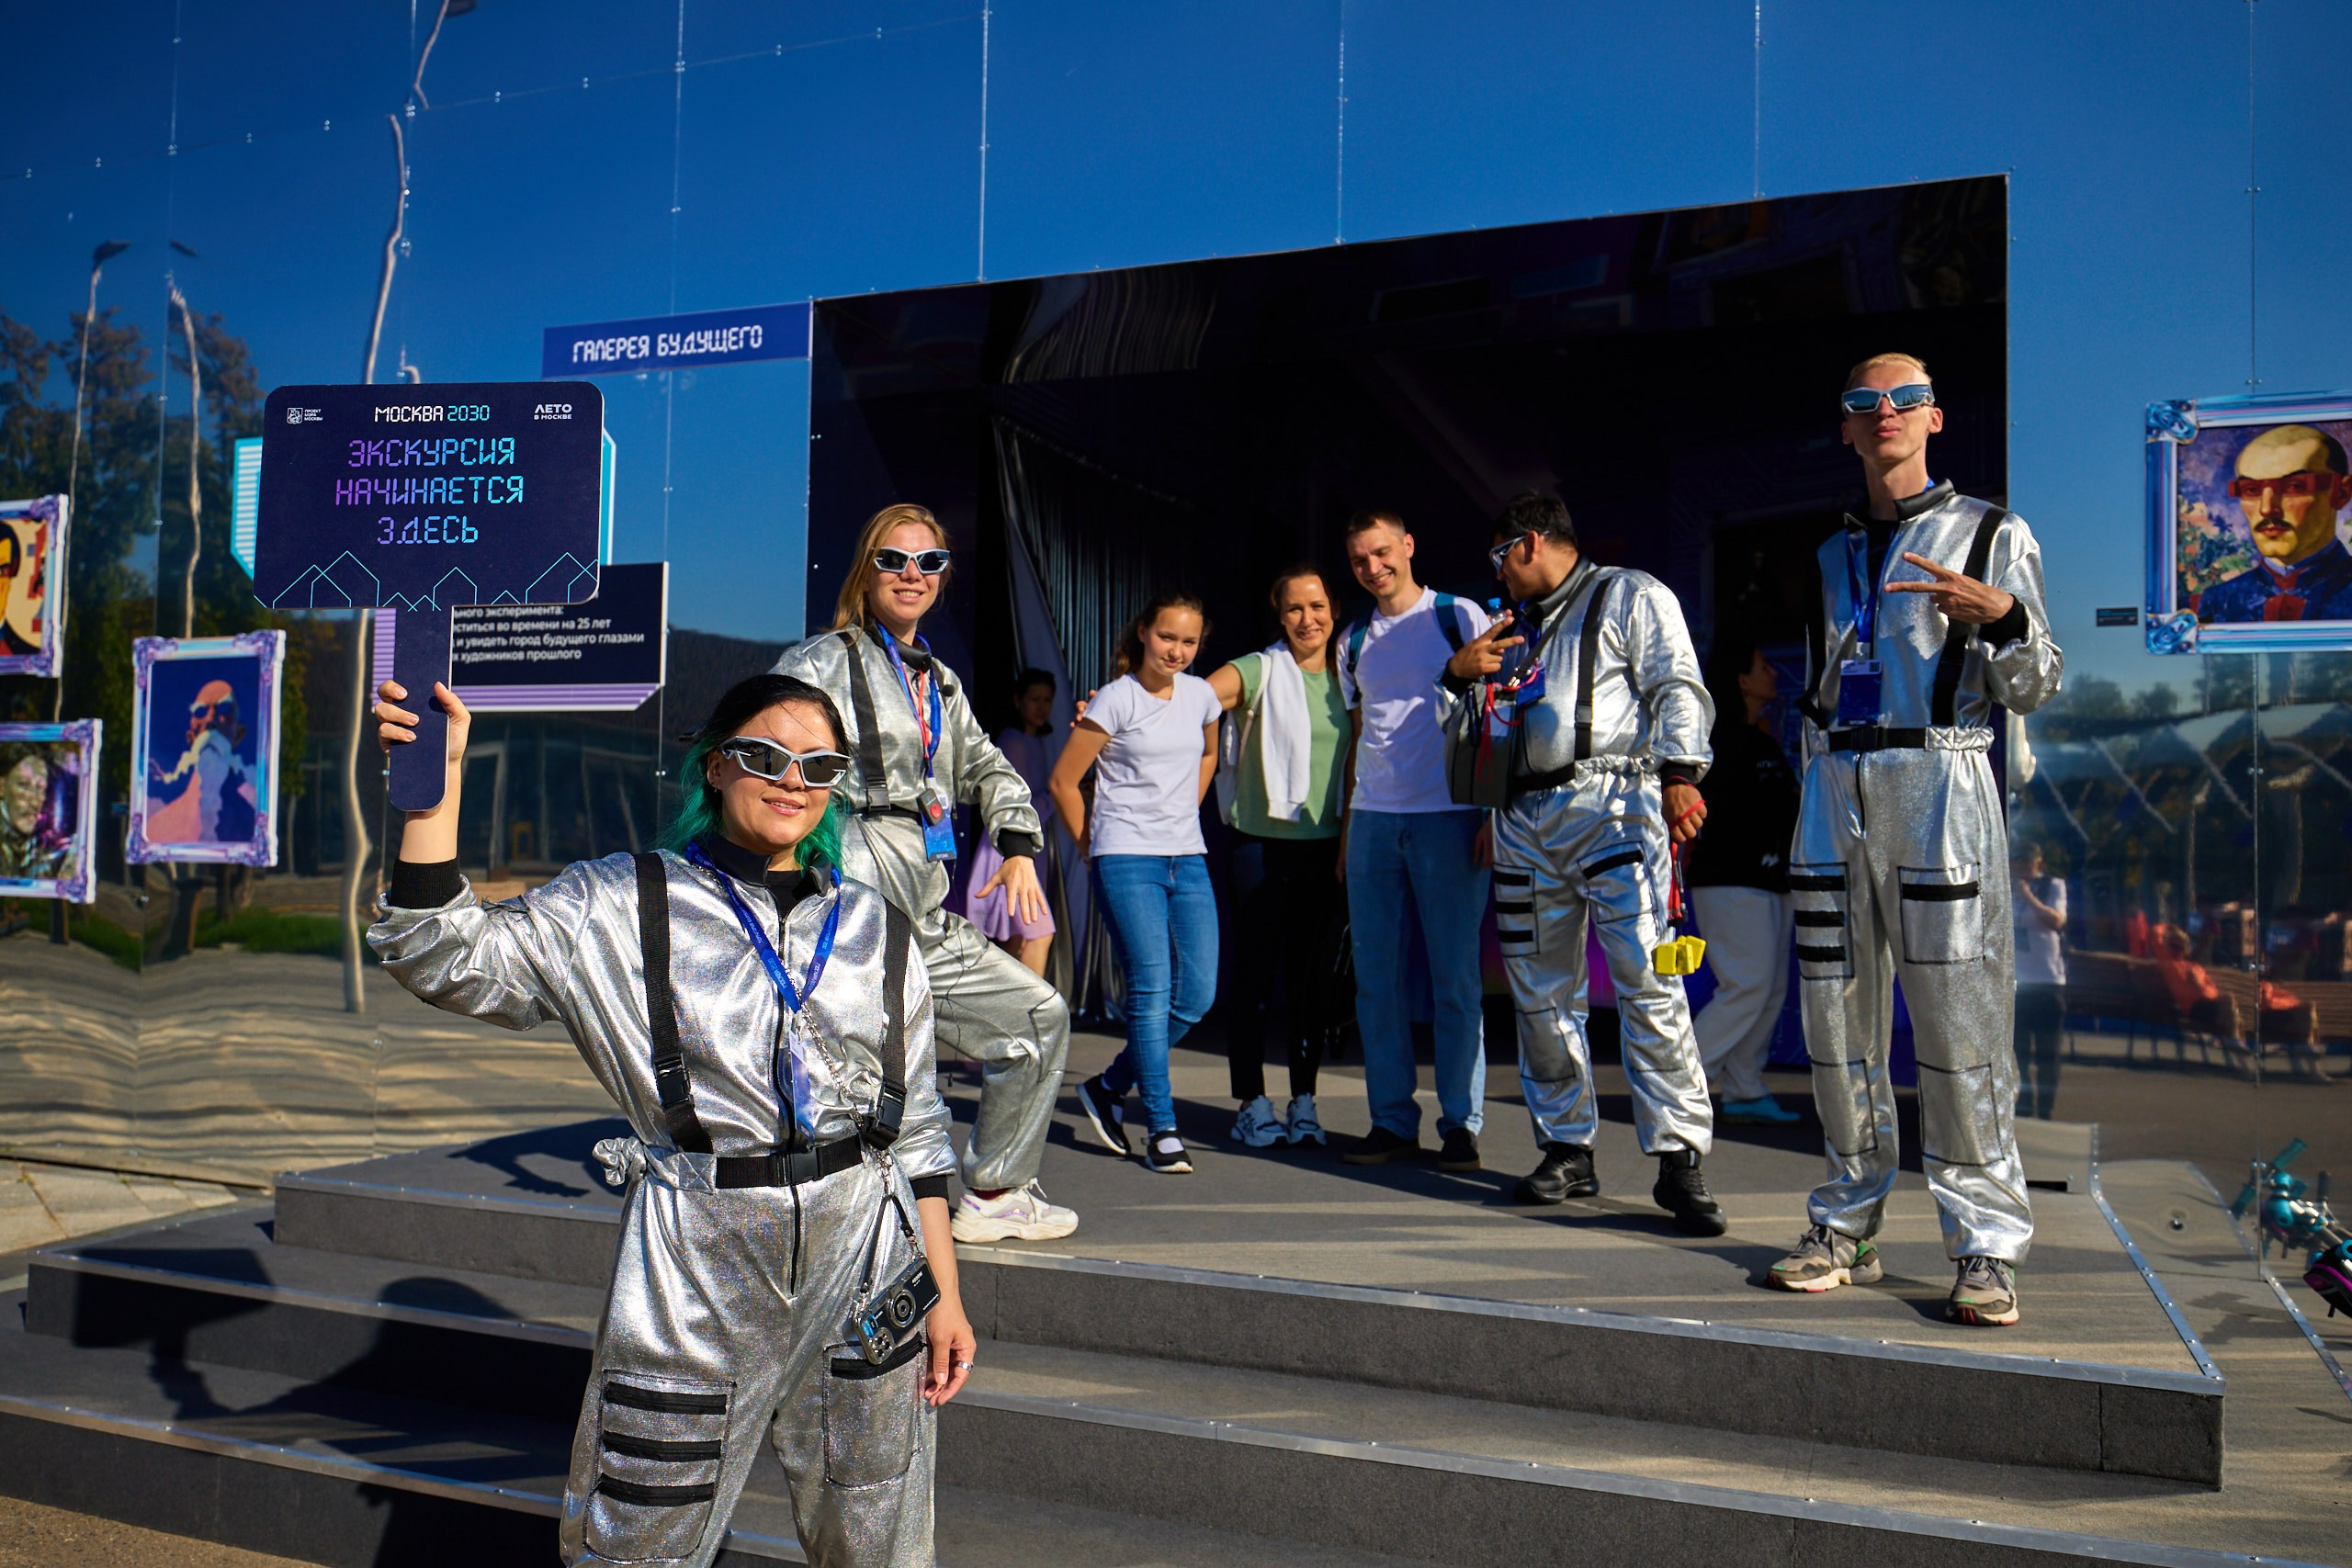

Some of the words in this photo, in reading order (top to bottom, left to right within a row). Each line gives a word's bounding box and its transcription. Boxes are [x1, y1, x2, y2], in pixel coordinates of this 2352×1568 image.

[572, 335, 650, 364] ГАЛЕРЕЯ
[657, 325, 763, 357] БУДУЩЕГО
[374, 405, 444, 423] МОСКВА
[447, 405, 491, 422] 2030
[534, 403, 572, 414] ЛЕТО
[348, 436, 515, 468] ЭКСКУРСИЯ
[335, 475, 524, 506] НАЧИНАЕТСЯ
[377, 515, 479, 545] ЗДЕСЬ
[454, 606, 484, 619] ьного
[485, 605, 564, 619] эксперимента:
[497, 621, 511, 632] во
[512, 620, 560, 634] времени
[561, 619, 576, 630] на
[577, 617, 591, 630] 25
[592, 617, 612, 629] лет
[457, 637, 464, 648] и
[465, 637, 508, 650] увидеть
[509, 635, 541, 649] город
[542, 632, 597, 648] будущего
[598, 632, 645, 644] глазами
[460, 650, 526, 663] художников
[526, 649, 582, 662] прошлого
[767, 956, 778, 971] 2030
[774, 969, 788, 989] МОСКВА
